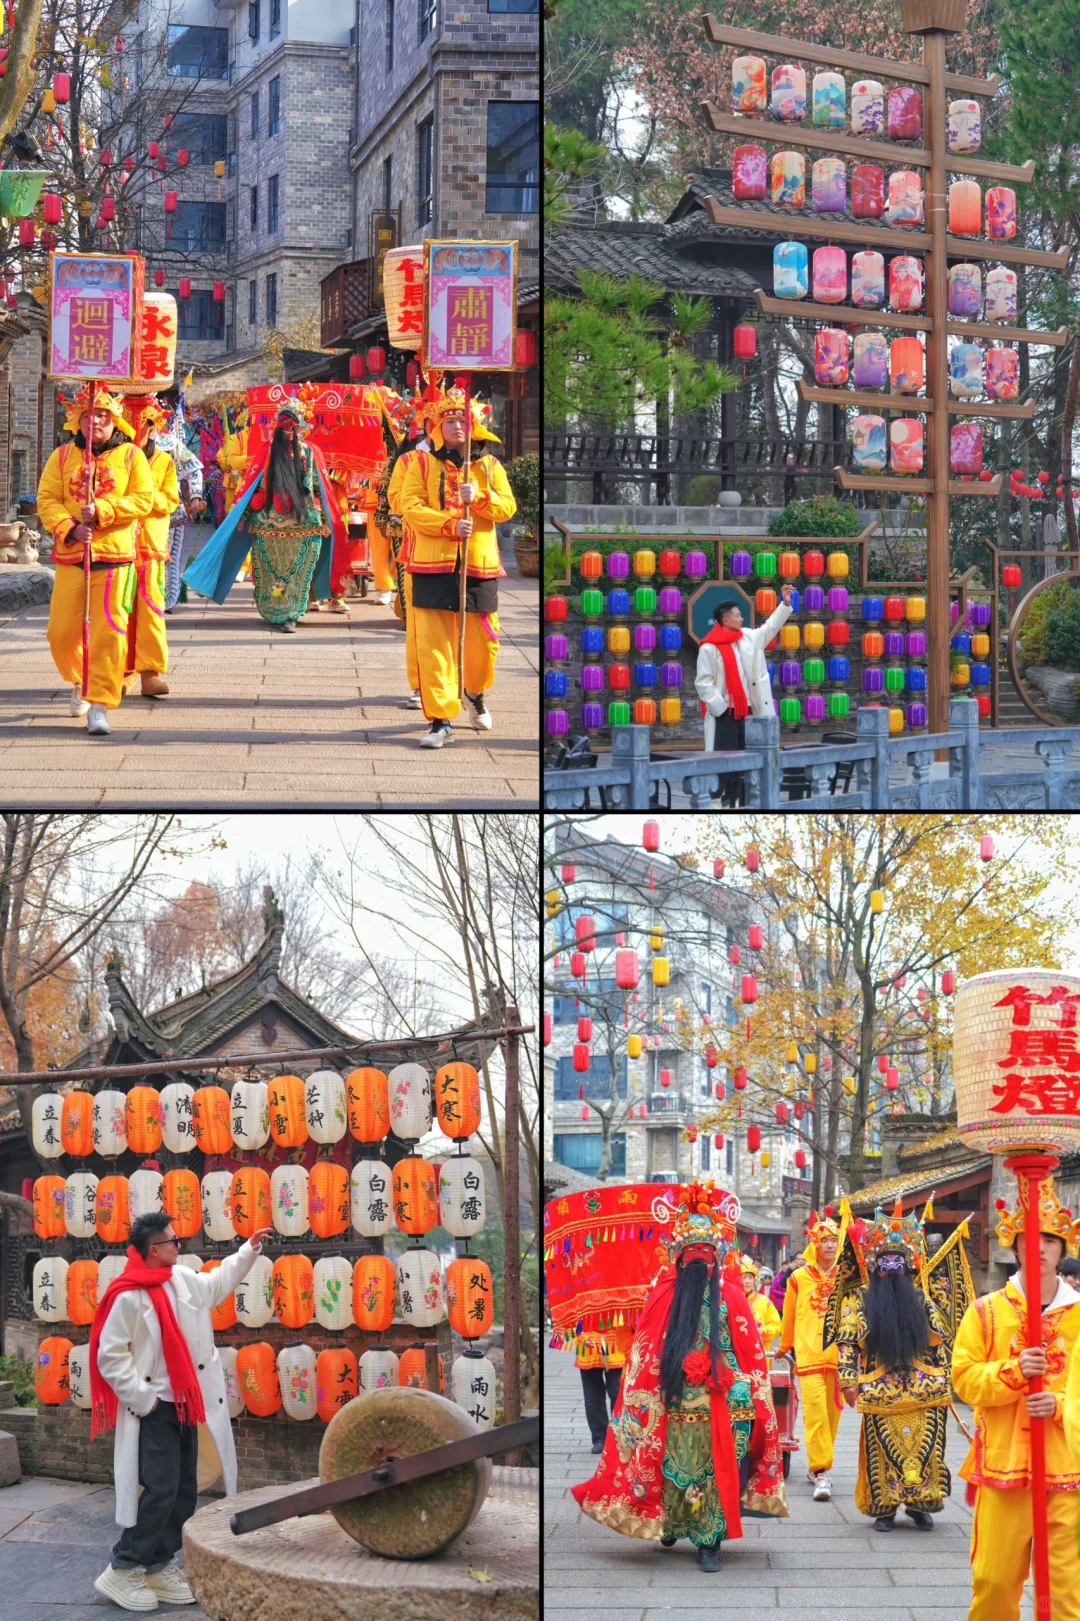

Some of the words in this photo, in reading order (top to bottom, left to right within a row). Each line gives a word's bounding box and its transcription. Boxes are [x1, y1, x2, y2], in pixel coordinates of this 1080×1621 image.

[70, 298, 111, 366] 迴避
[141, 306, 175, 380] 永泉
[451, 287, 492, 355] 肅靜
[175, 1094, 196, 1138] 清明
[231, 1092, 248, 1137] 立夏
[270, 1091, 288, 1136] 小雪
[306, 1084, 325, 1129] 芒种
[440, 1074, 462, 1122] 大寒
[42, 1105, 61, 1145] 立春
[82, 1184, 97, 1226] 谷雨
[233, 1177, 249, 1223] 立冬
[367, 1173, 389, 1222] 白露
[393, 1175, 412, 1223] 小寒
[460, 1171, 482, 1221] 白露
[38, 1271, 57, 1312] 立春
[235, 1282, 250, 1315] 夏
[273, 1272, 289, 1318] 秋分
[398, 1267, 414, 1314] 小暑
[468, 1273, 489, 1322] 处暑
[70, 1361, 84, 1400] 雨水
[467, 1375, 490, 1423] 雨水
